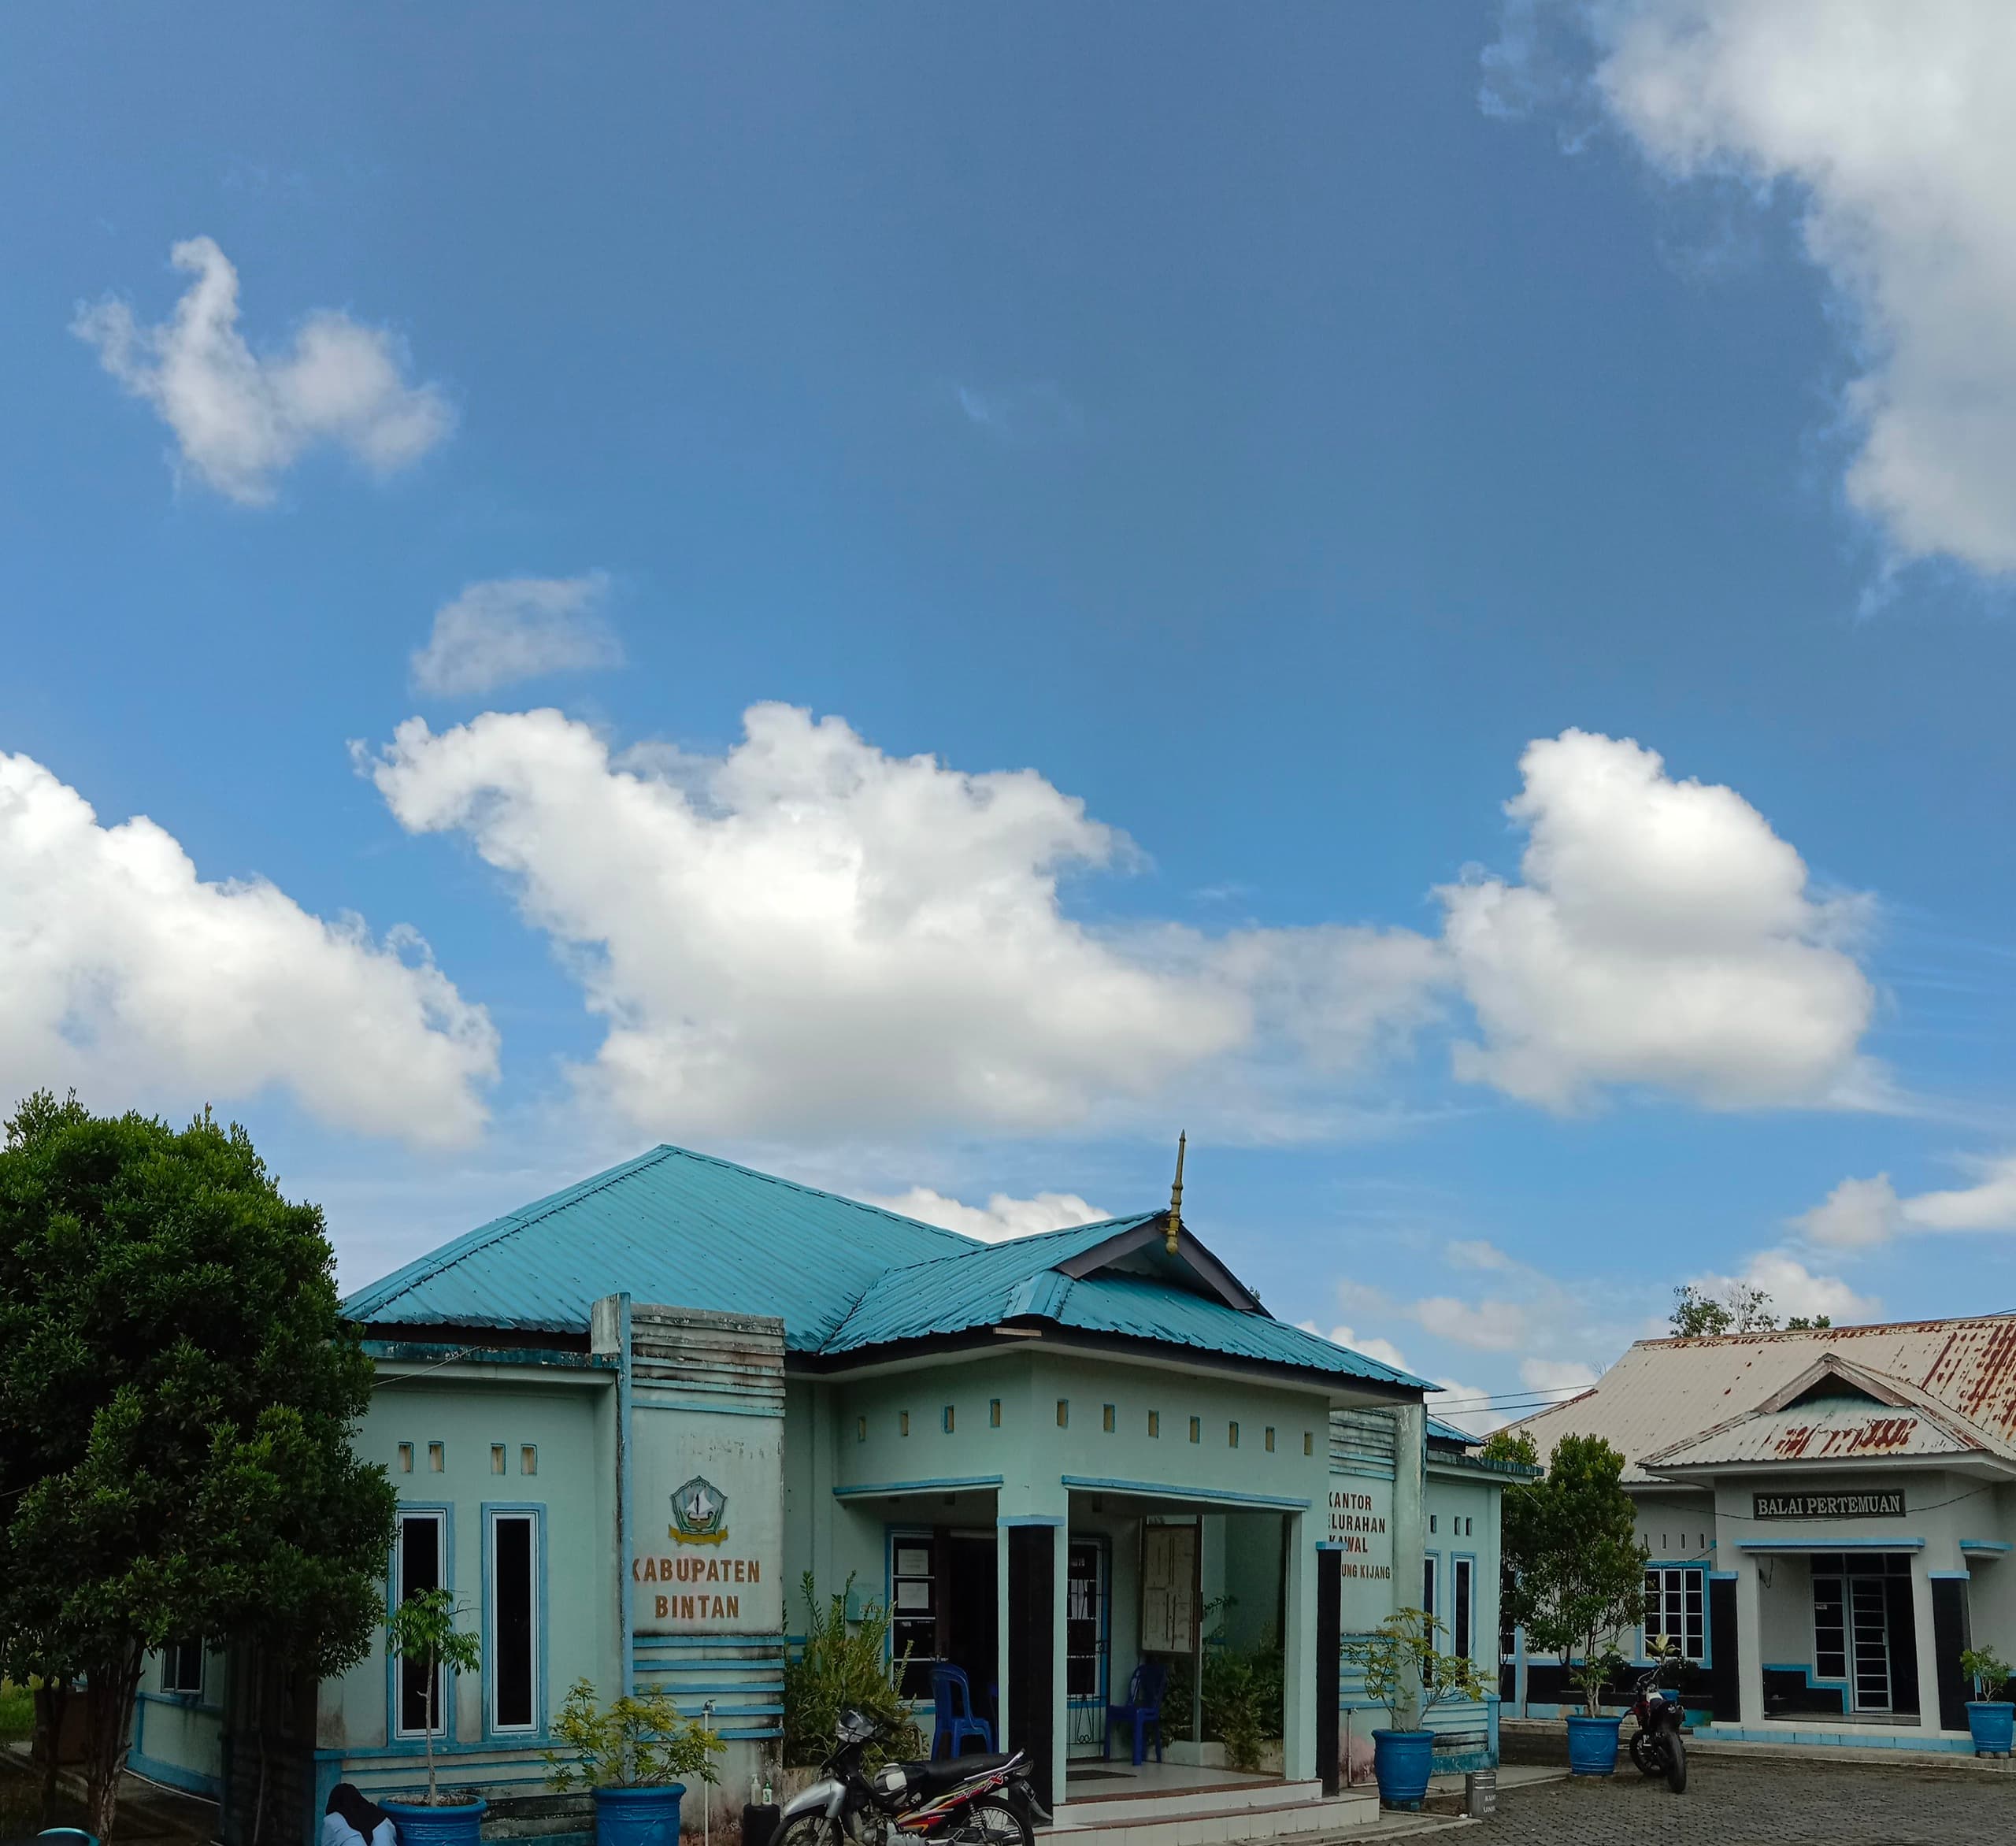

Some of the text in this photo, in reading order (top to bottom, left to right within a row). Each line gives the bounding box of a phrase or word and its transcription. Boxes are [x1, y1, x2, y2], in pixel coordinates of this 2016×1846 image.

[1757, 1495, 1901, 1515] BALAI PERTEMUAN
[1328, 1512, 1386, 1534] LURAHAN
[1341, 1563, 1391, 1580] UNG KIJANG
[654, 1595, 739, 1620] BINTAN
